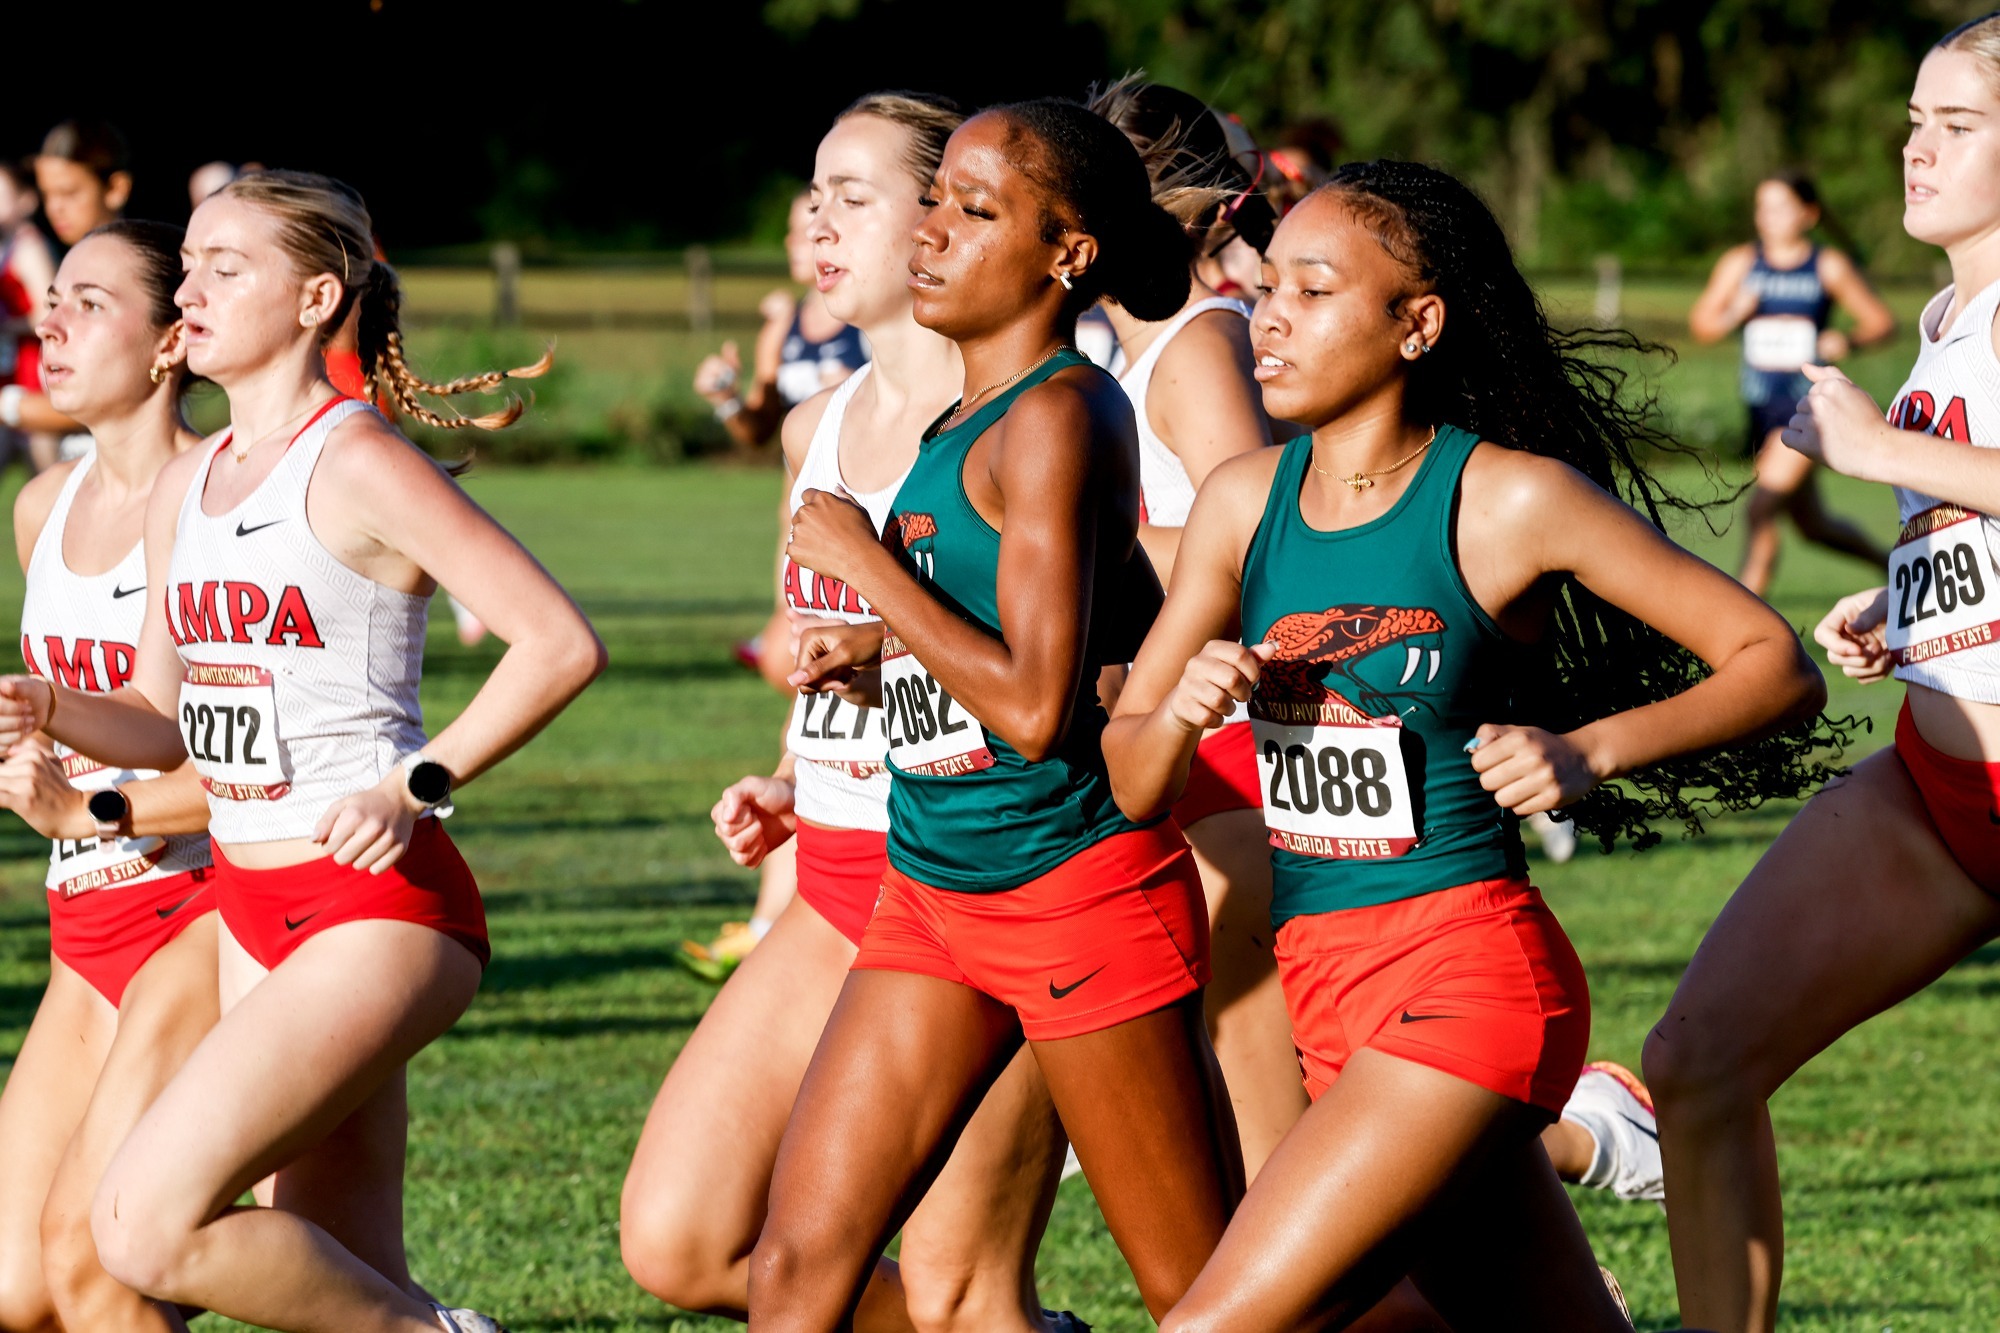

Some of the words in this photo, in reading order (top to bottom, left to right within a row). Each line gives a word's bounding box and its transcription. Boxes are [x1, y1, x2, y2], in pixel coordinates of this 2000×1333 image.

[785, 558, 879, 615] AM
[1895, 542, 1985, 630] 2269
[1903, 637, 1949, 663] FLORIDA
[1951, 624, 1992, 650] STATE
[183, 701, 267, 765] 2272
[883, 674, 968, 749] 2092
[1267, 702, 1288, 721] FSU
[1292, 703, 1372, 726] INVITATION
[1264, 739, 1392, 818] 2088
[1281, 831, 1334, 857] FLORIDA
[1339, 838, 1391, 857] STATE
[65, 871, 109, 897] FLORIDA
[110, 856, 151, 882] STATE
